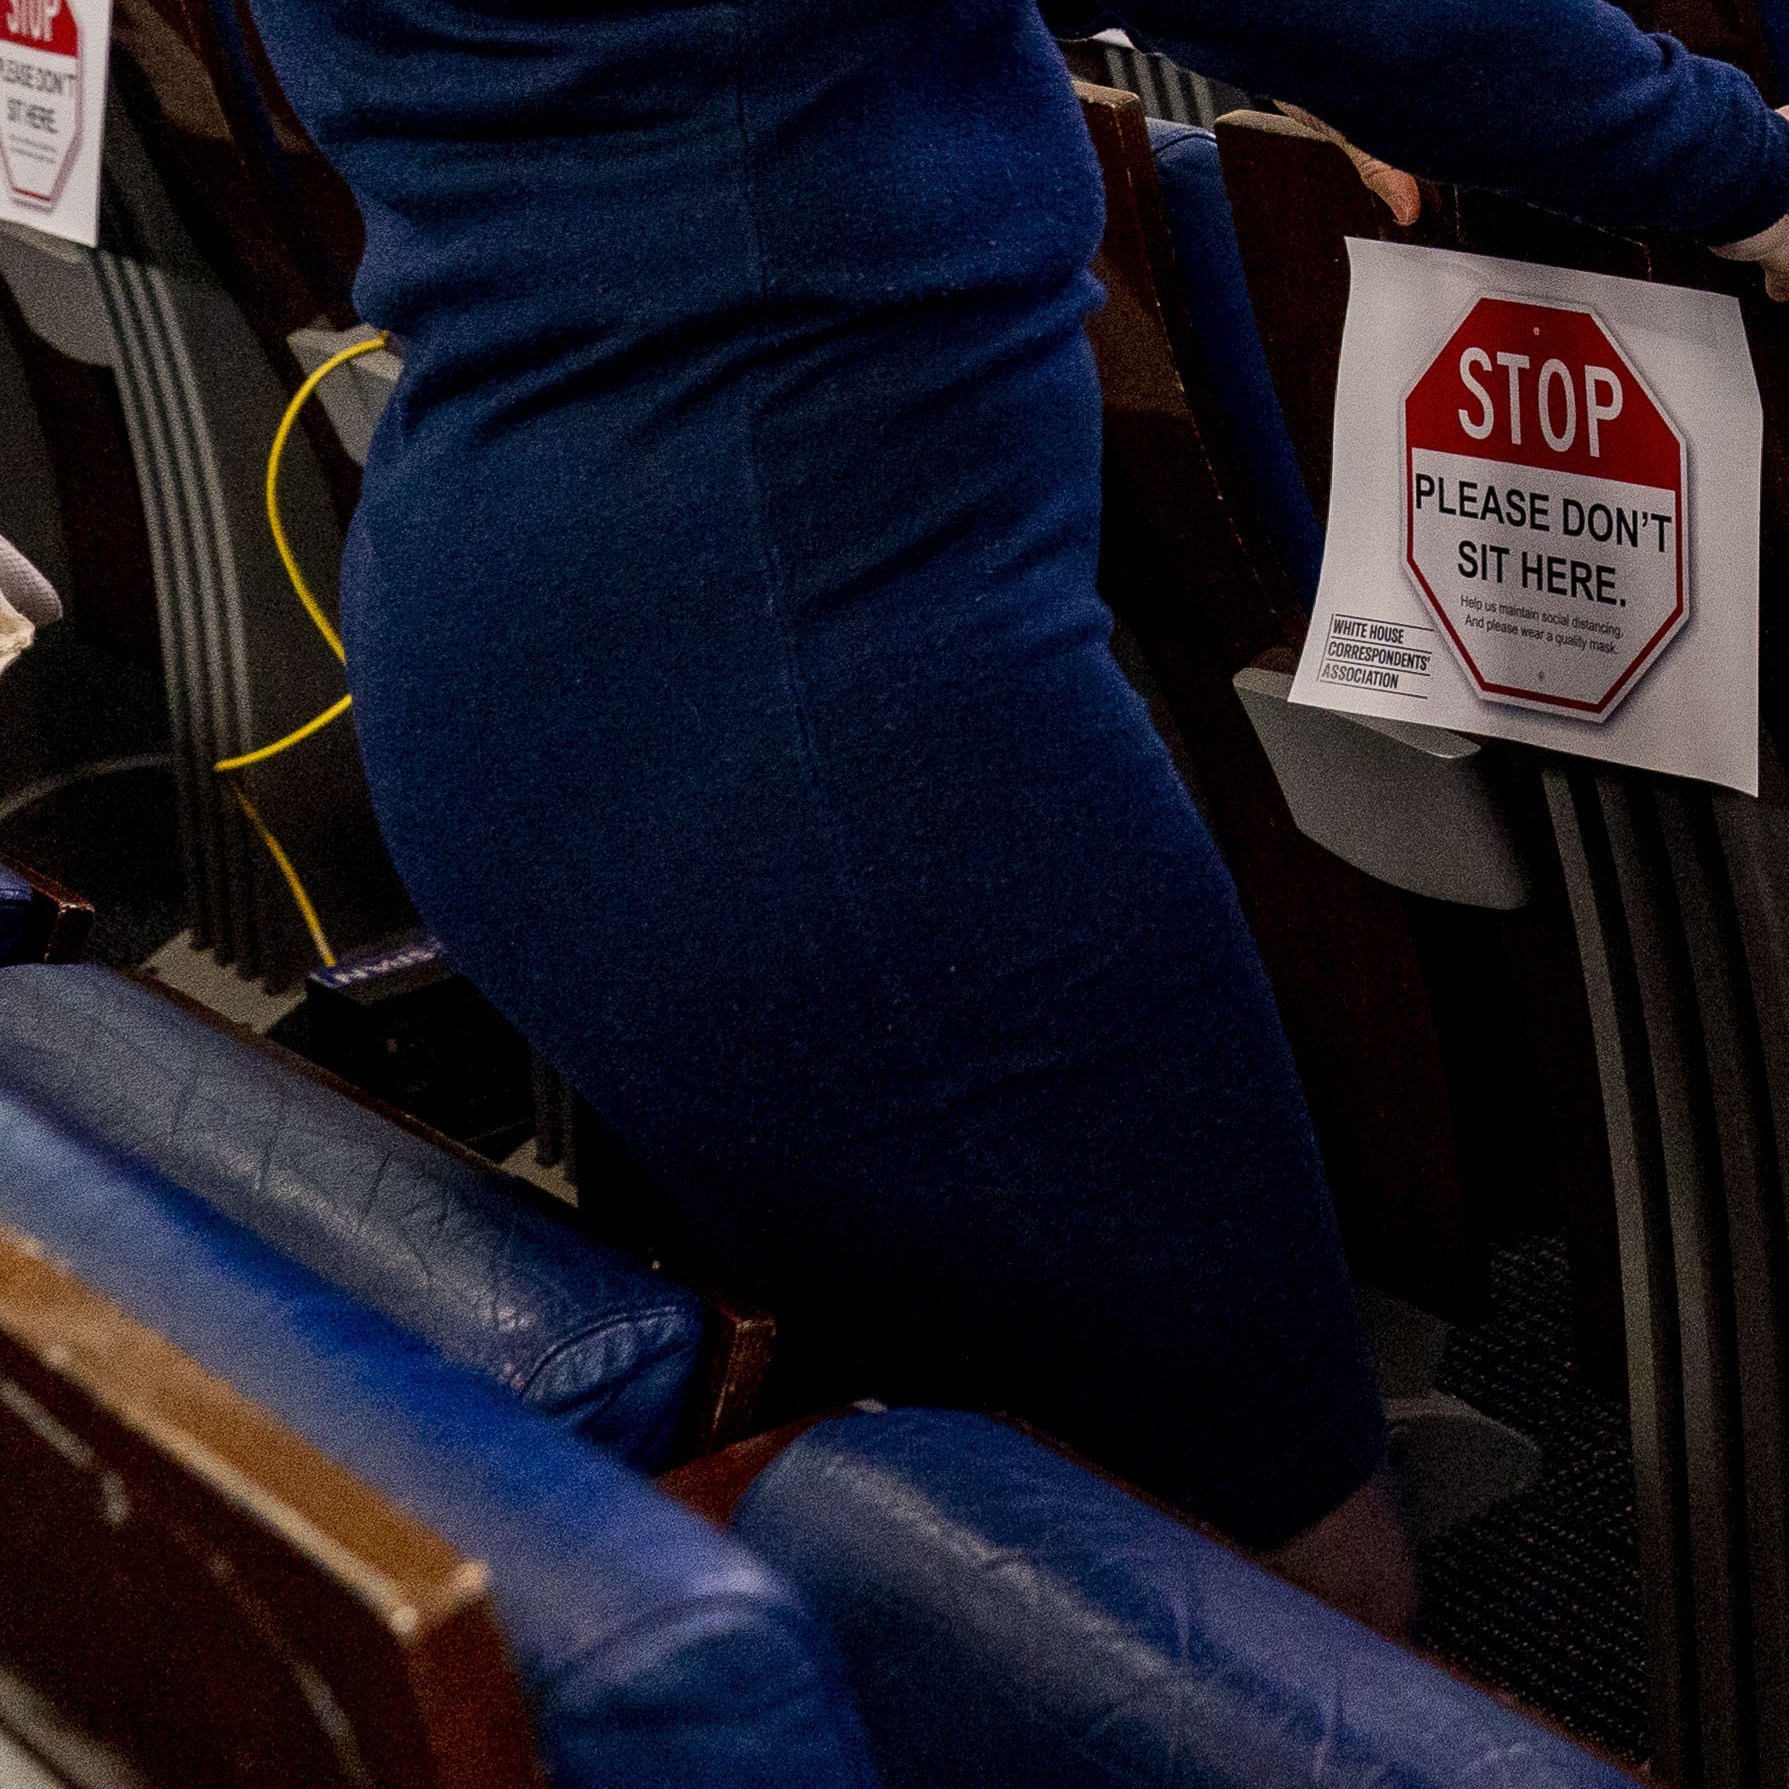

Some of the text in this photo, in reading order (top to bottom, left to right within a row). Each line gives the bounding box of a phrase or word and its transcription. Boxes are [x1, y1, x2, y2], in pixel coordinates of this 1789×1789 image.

[1458, 346, 1624, 457] STOP
[1415, 473, 1672, 553] PLEASE DON'T
[1457, 539, 1627, 608] SIT HERE.
[1460, 595, 1483, 611] Help
[1485, 602, 1497, 612] us
[1500, 604, 1539, 621] maintain
[1541, 612, 1570, 627] social
[1333, 619, 1404, 644] WHITE HOUSE
[1465, 614, 1484, 629] And
[1486, 618, 1518, 635] please
[1520, 627, 1544, 640] wear
[1555, 633, 1587, 651] quality
[1589, 640, 1618, 655] mask.
[1328, 641, 1431, 671] CORRESPONDENTS'
[1321, 663, 1399, 689] ASSOCIATION
